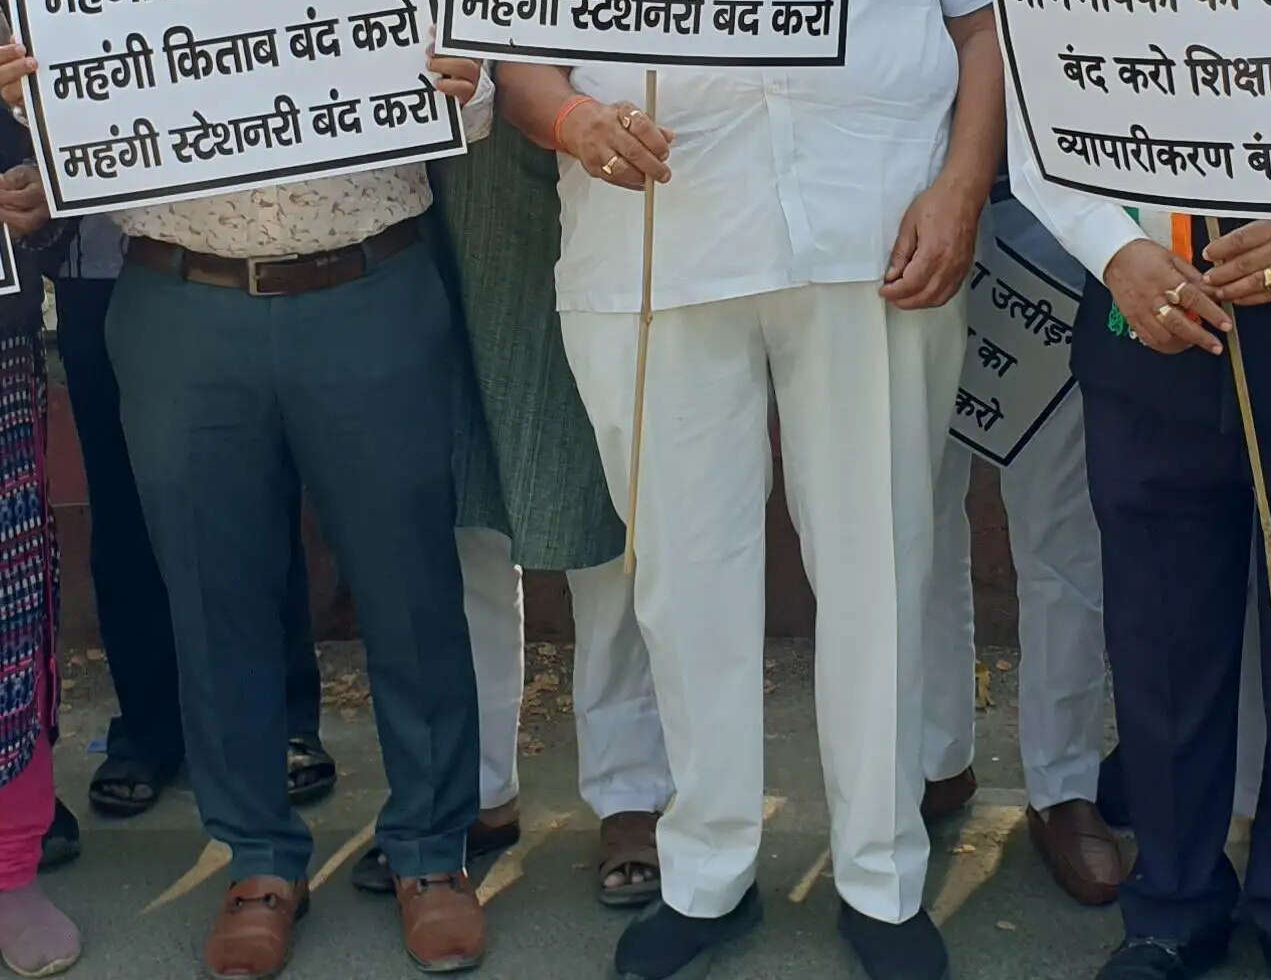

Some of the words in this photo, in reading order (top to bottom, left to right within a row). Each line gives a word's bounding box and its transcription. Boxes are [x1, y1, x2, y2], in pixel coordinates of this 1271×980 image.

[1057, 44, 1109, 94] बंद
[1112, 43, 1177, 96] करो
[58, 117, 162, 179] महंगी
[167, 94, 302, 164] स्टेशनरी
[308, 88, 363, 138] बंद
[369, 73, 439, 129] करो
[1051, 124, 1235, 180] व्यापारीकरण
[978, 337, 1018, 378] का
